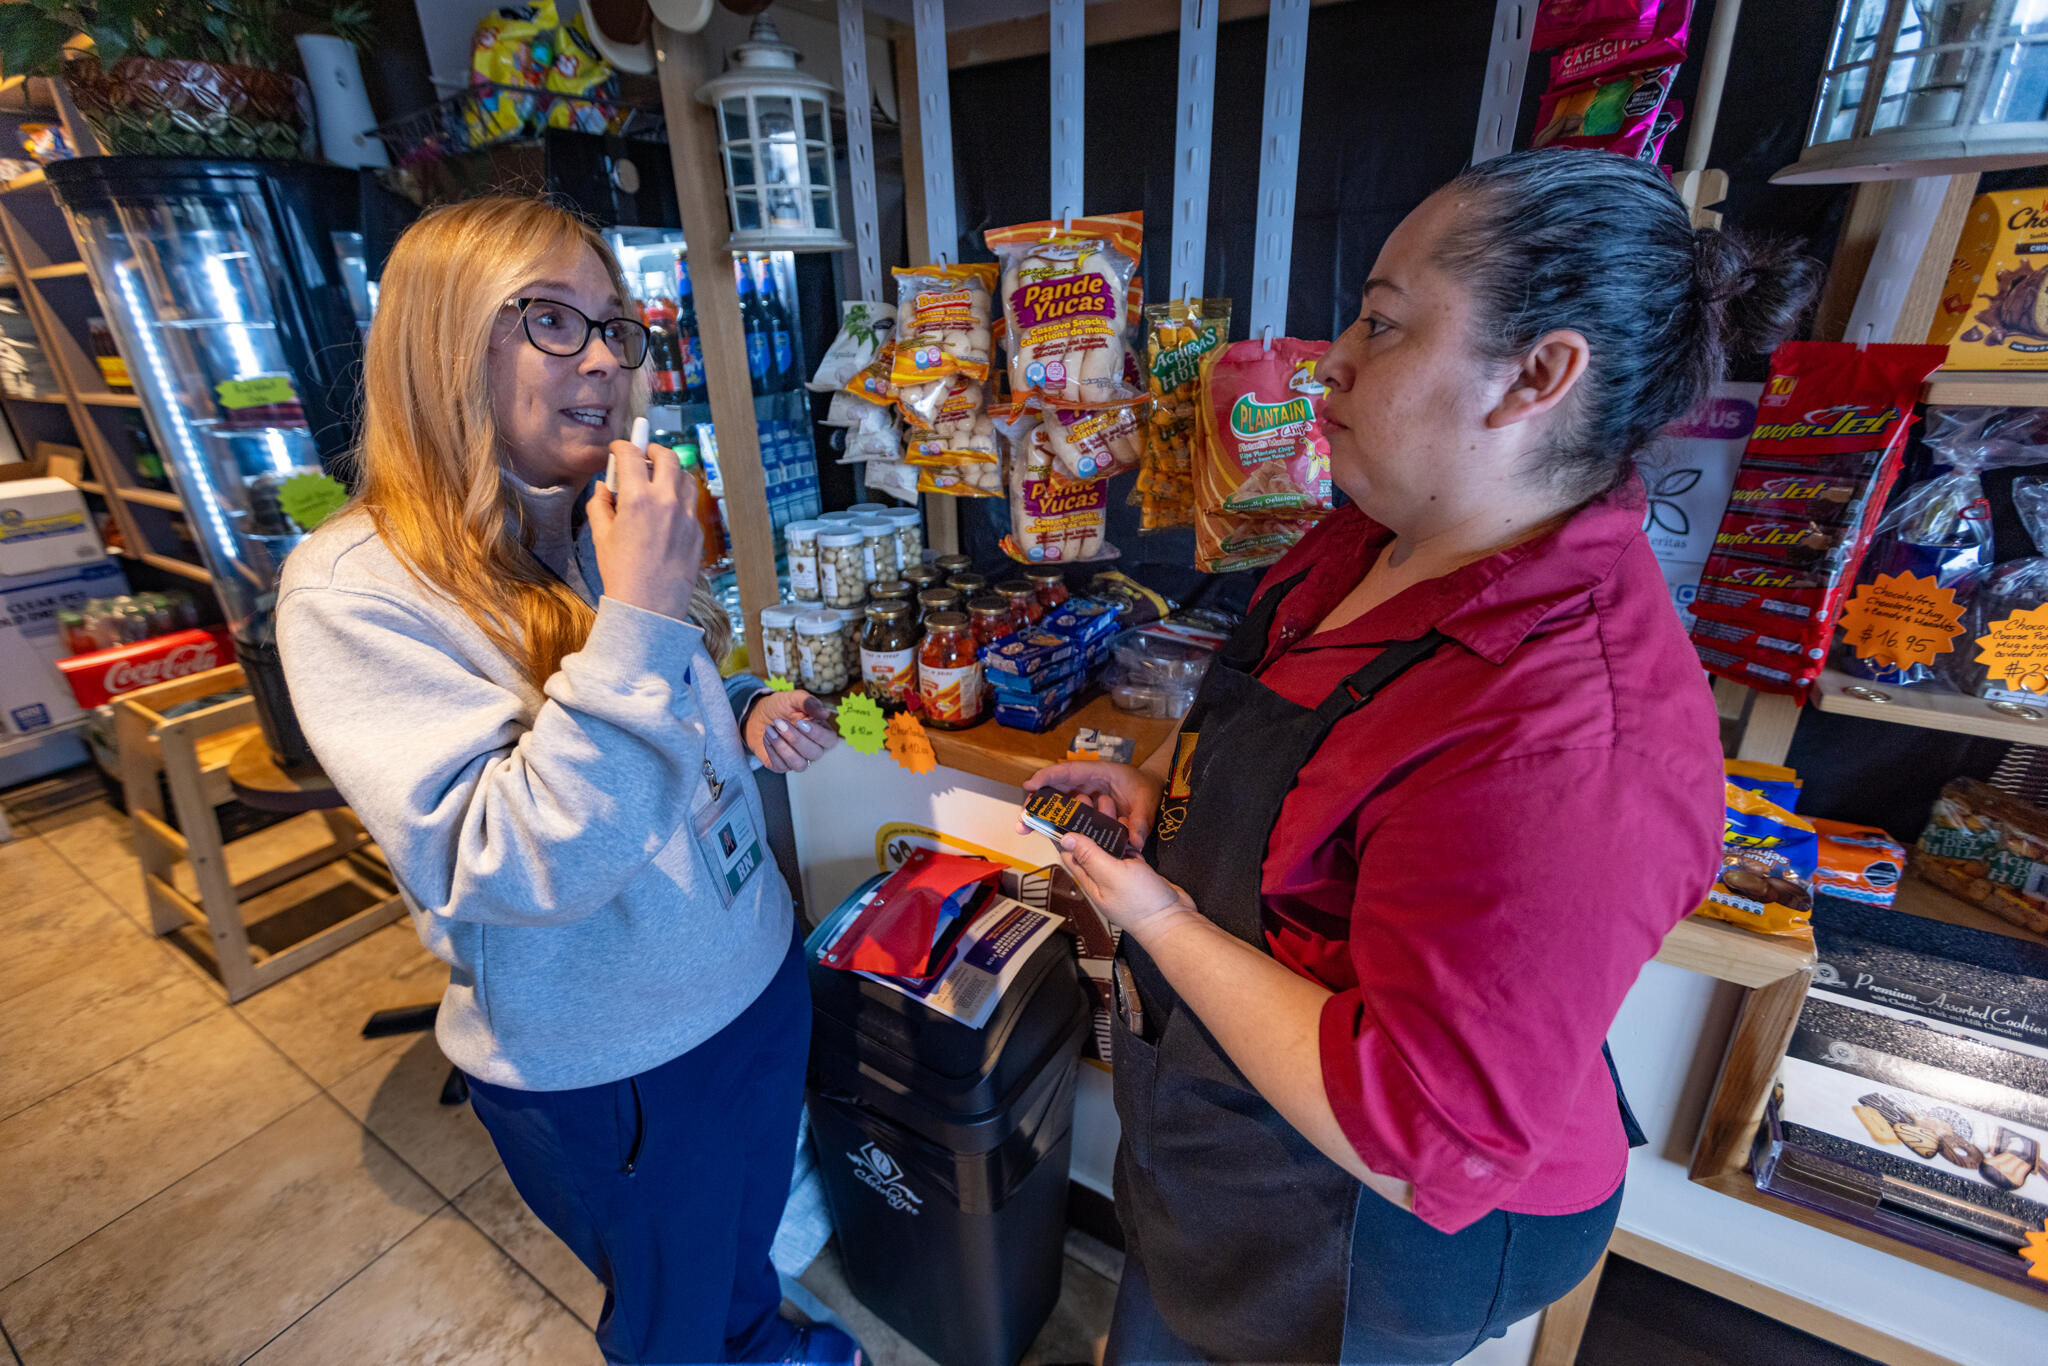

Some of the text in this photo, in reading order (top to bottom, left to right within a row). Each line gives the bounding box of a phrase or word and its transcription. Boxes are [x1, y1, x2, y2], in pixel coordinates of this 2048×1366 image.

[1023, 274, 1103, 308] Pande
[1033, 295, 1106, 322] Yucas
[1030, 317, 1107, 336] Cassava Snacks
[1020, 330, 1068, 348] Collations
[1070, 328, 1083, 336] de
[1770, 376, 1796, 395] 10
[1239, 400, 1306, 432] PLANTAIN
[1751, 410, 1899, 441] Wafer Jet
[1280, 422, 1313, 438] Chips
[1265, 495, 1301, 505] Delicious
[1768, 482, 1829, 499] Jet
[1039, 491, 1100, 514] Yucas
[1751, 528, 1810, 545] Jet
[735, 853, 755, 883] RN
[1854, 972, 2048, 1036] Premium Assorted Cookies
